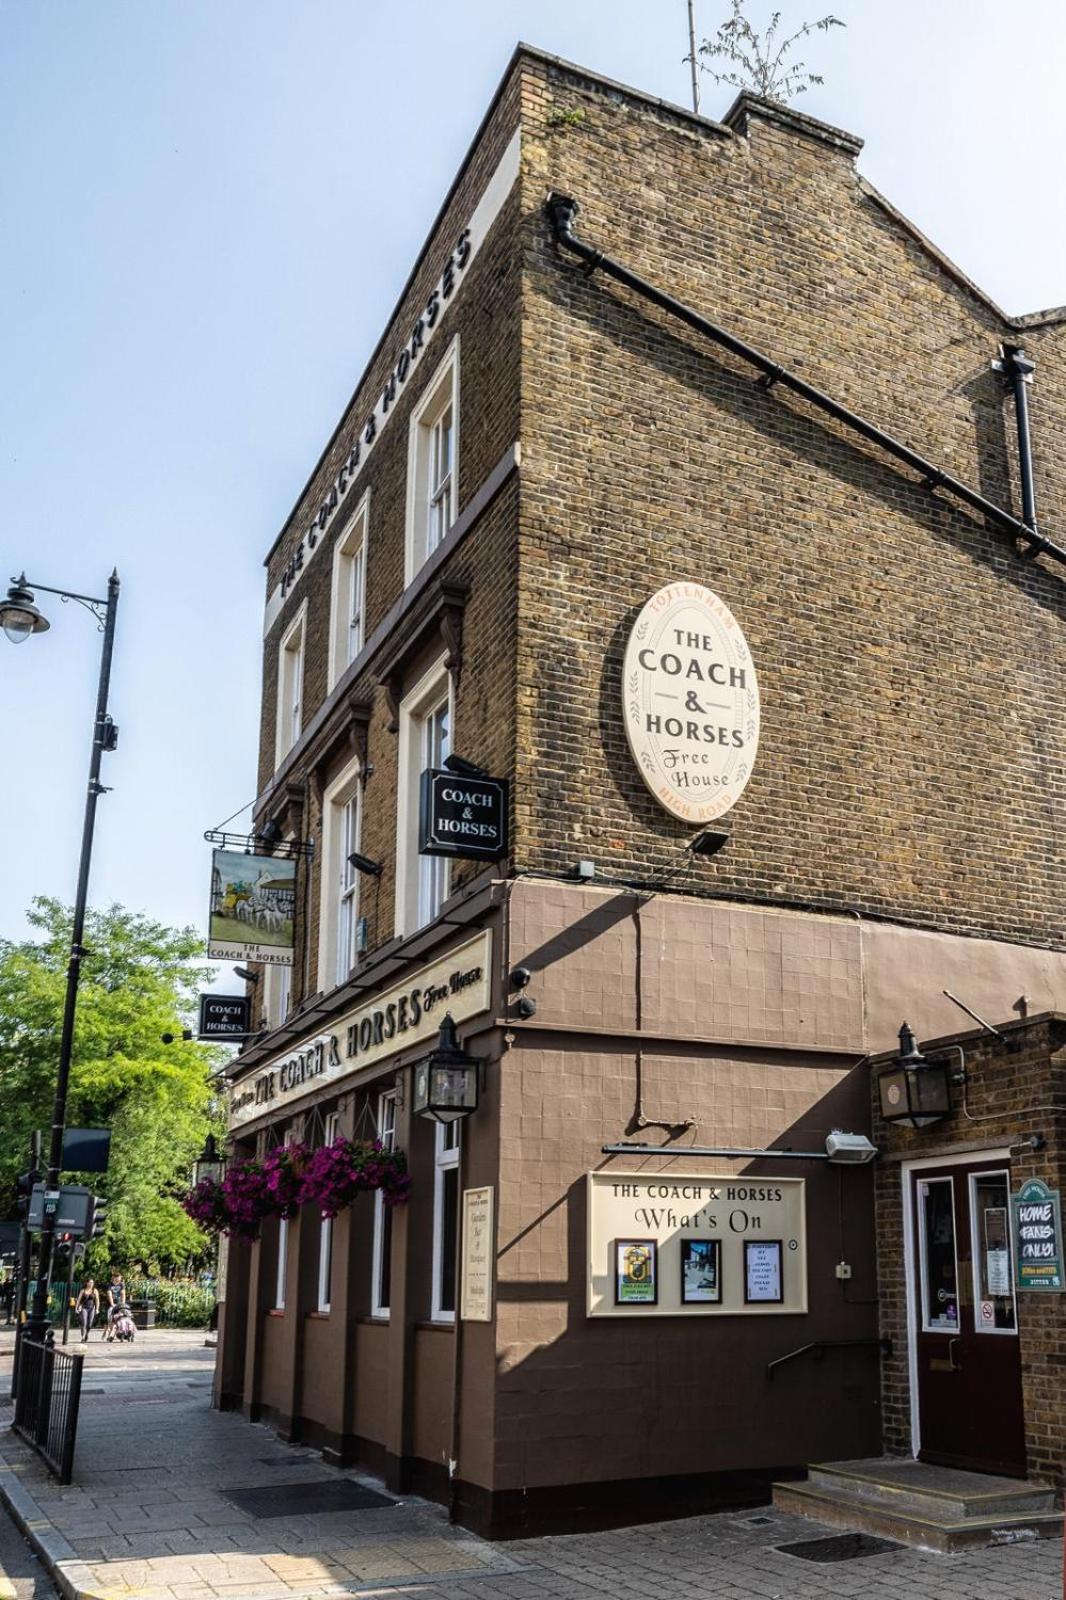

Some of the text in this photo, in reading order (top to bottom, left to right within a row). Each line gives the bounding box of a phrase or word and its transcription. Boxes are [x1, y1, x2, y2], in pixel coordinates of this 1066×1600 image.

[280, 228, 471, 598] THE COACH & HORSES
[650, 584, 735, 630] TOTTENHAM
[673, 629, 713, 651] THE
[638, 648, 747, 689] COACH
[685, 690, 707, 714] &
[646, 714, 744, 748] HORSES
[663, 749, 709, 768] Free
[671, 771, 729, 787] House
[441, 788, 493, 807] COACH
[658, 786, 733, 821] HIGH ROAD
[462, 807, 473, 819] &
[437, 818, 497, 838] HORSES
[210, 949, 242, 959] COACH
[256, 953, 291, 963] HORSES
[244, 944, 260, 952] THE
[209, 1005, 241, 1015] COACH
[206, 1022, 244, 1032] HORSES
[254, 1071, 274, 1106] THE
[279, 1040, 323, 1093] COACH
[328, 1035, 341, 1067] &
[346, 989, 422, 1059] HORSES
[612, 1184, 782, 1202] THE COACH & HORSES
[634, 1207, 762, 1233] What's On
[1019, 1204, 1052, 1223] HOME
[1021, 1225, 1051, 1240] FANS
